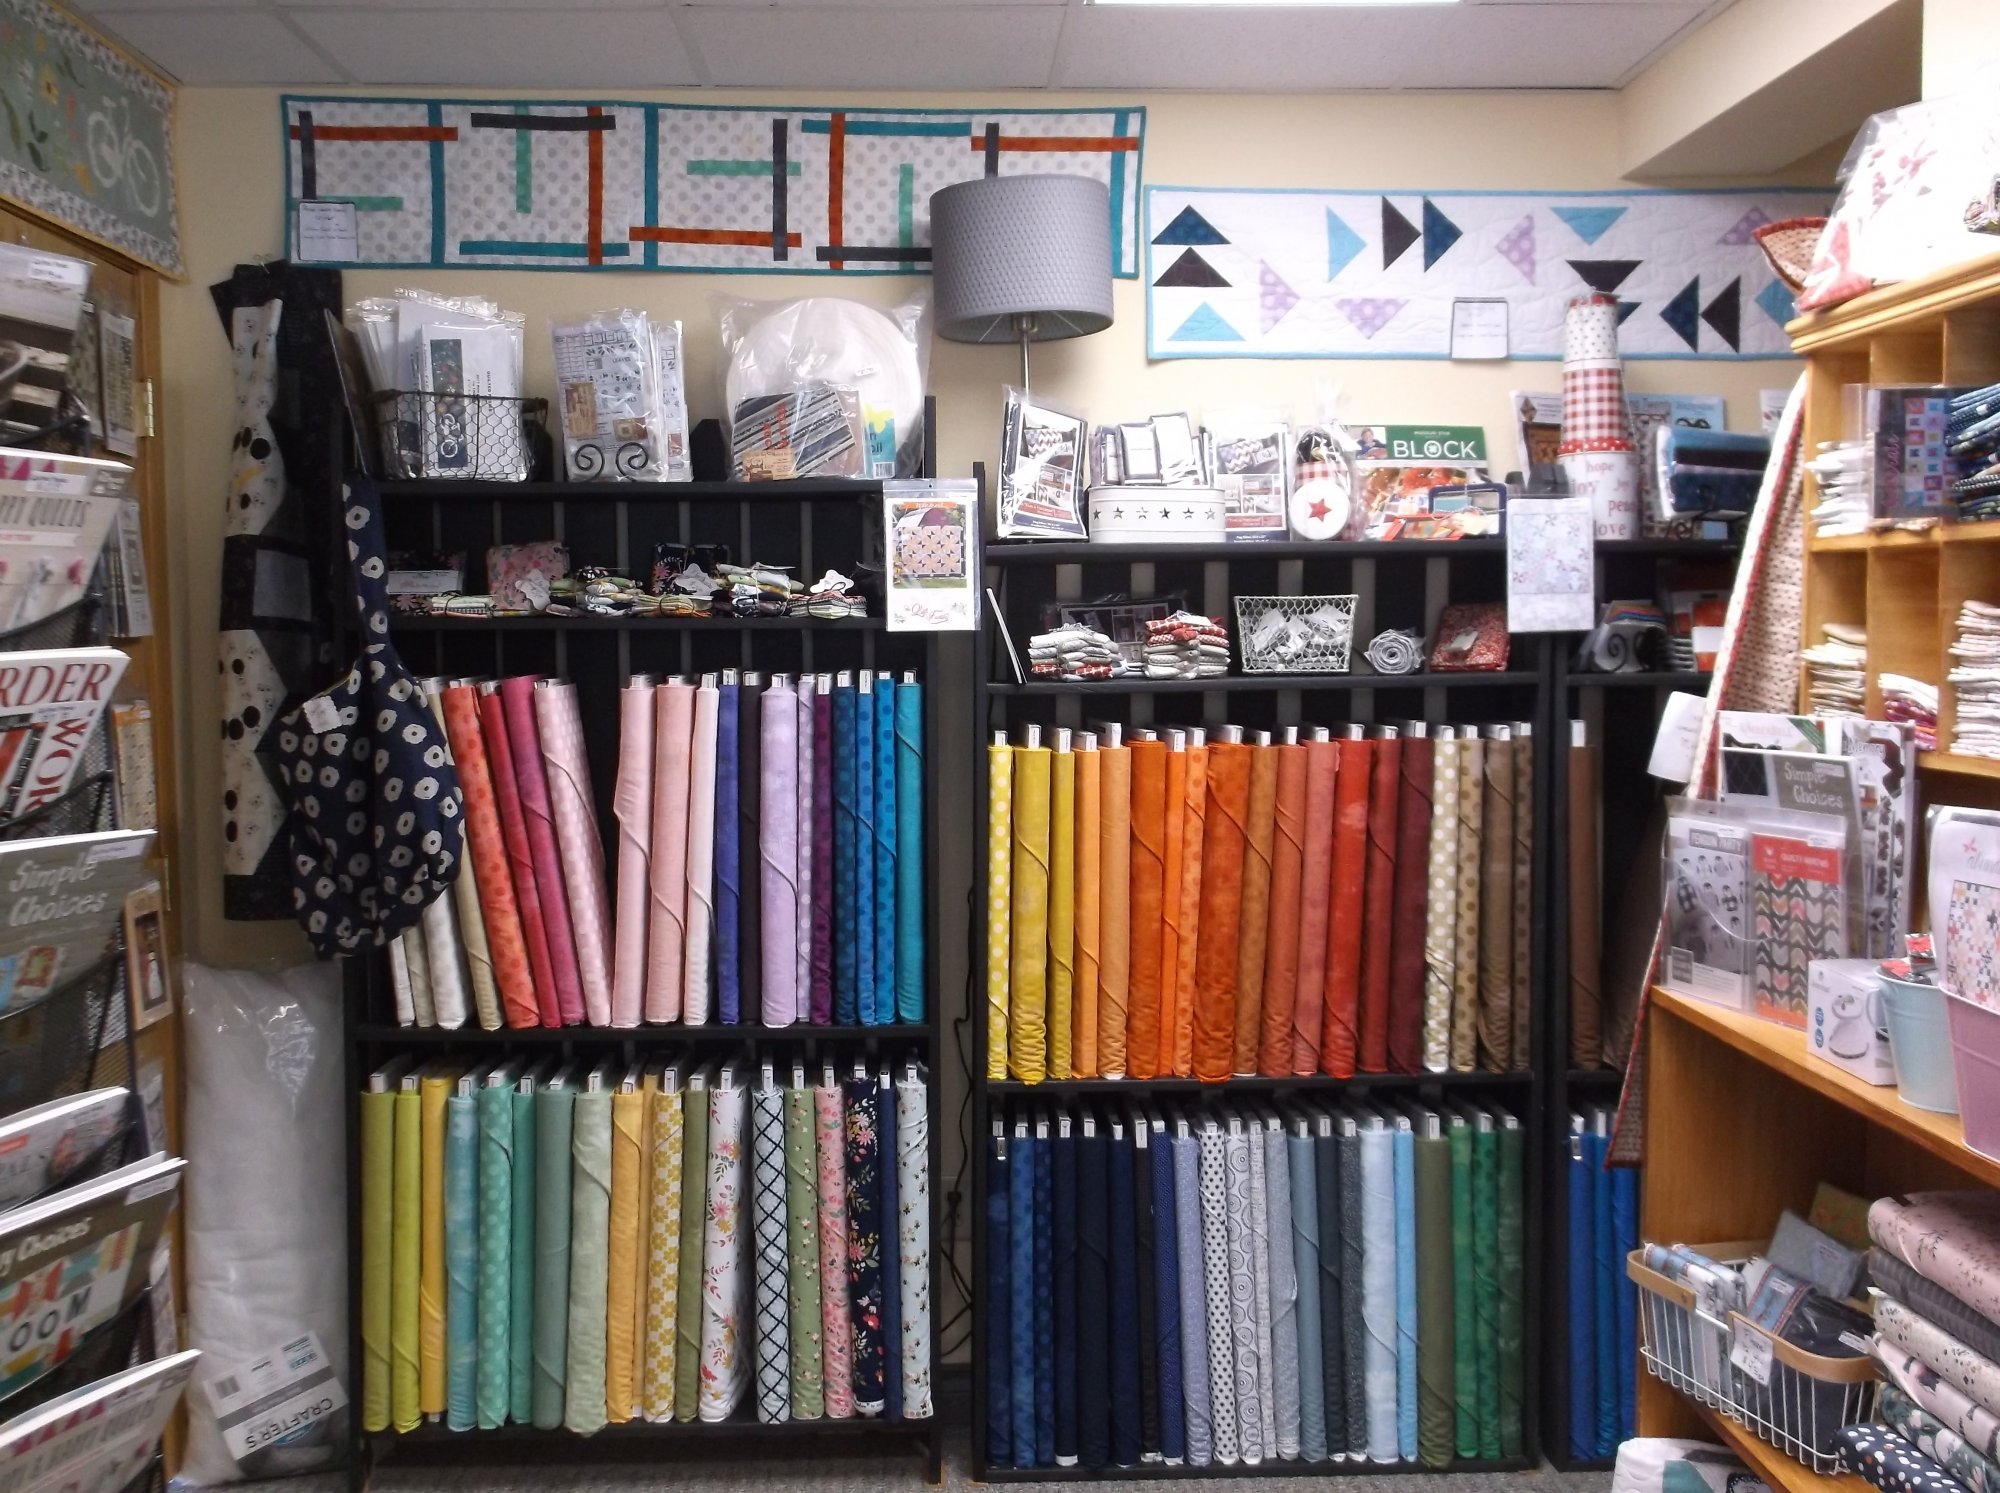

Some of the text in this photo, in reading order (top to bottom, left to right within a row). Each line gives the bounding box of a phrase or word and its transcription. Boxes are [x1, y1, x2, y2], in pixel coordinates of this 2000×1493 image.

[1393, 440, 1477, 458] BLOCK
[1586, 460, 1615, 475] hope
[1594, 519, 1627, 536] love
[1783, 760, 1827, 789] Simple
[1792, 784, 1844, 809] Choices
[9, 851, 98, 895] Simple
[9, 892, 109, 927] Choices
